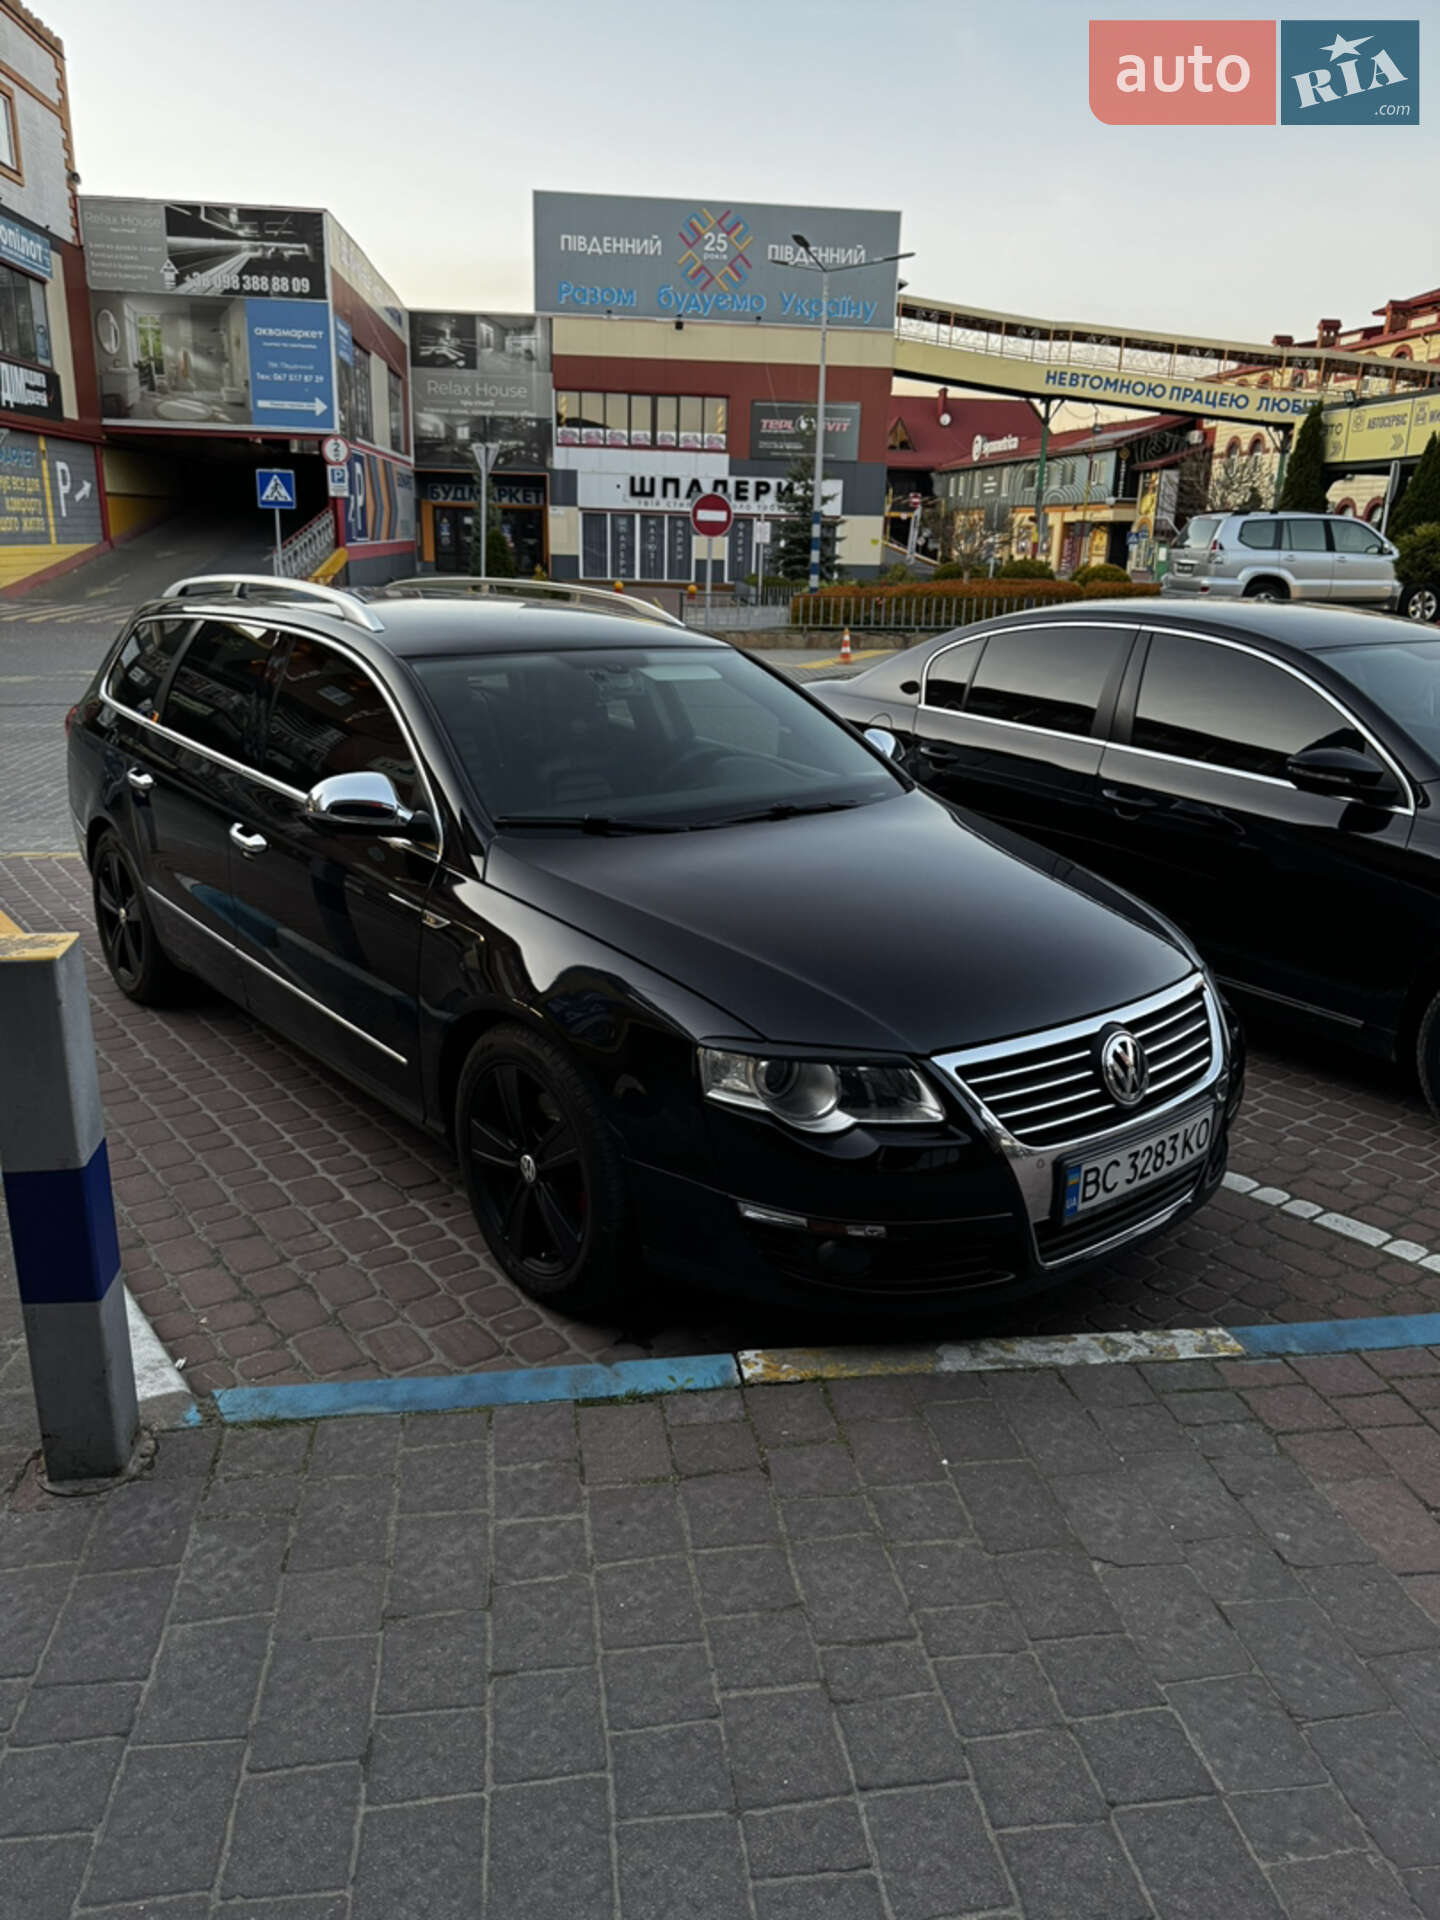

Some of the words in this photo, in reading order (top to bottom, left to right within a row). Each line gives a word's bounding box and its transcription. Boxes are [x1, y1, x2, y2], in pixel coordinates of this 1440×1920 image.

[560, 233, 662, 257] ПІВДЕННИЙ
[704, 232, 729, 252] 25
[767, 244, 867, 264] ПІВДЕННИЙ
[291, 276, 311, 294] 09
[557, 280, 638, 307] Разом
[657, 284, 767, 316] будуємо
[779, 291, 878, 324] Україну
[253, 327, 324, 340] аквамаркет
[427, 380, 471, 397] Relax
[475, 382, 528, 399] House
[1045, 370, 1166, 399] НЕВТОМНОЮ
[1169, 387, 1249, 410] ПРАЦЕЮ
[56, 460, 71, 518] P
[1081, 1159, 1121, 1203] BC
